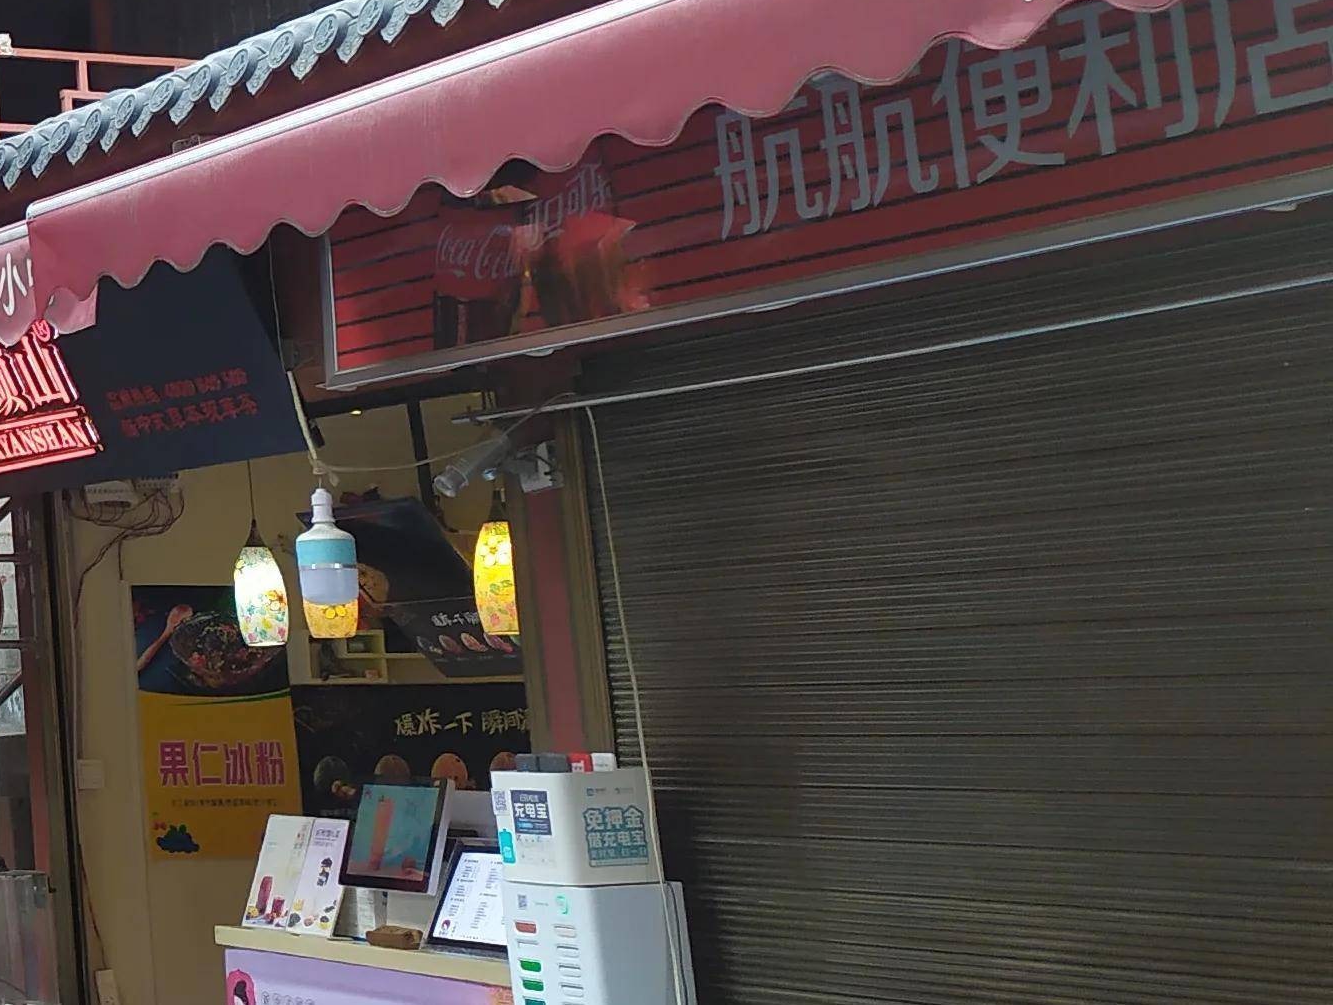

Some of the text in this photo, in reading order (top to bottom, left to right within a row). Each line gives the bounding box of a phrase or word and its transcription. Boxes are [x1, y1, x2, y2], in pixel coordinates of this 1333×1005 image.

[395, 708, 473, 737] 爆炸一下
[158, 740, 286, 788] 果仁冰粉
[513, 802, 548, 819] 充电宝
[584, 806, 644, 831] 免押金
